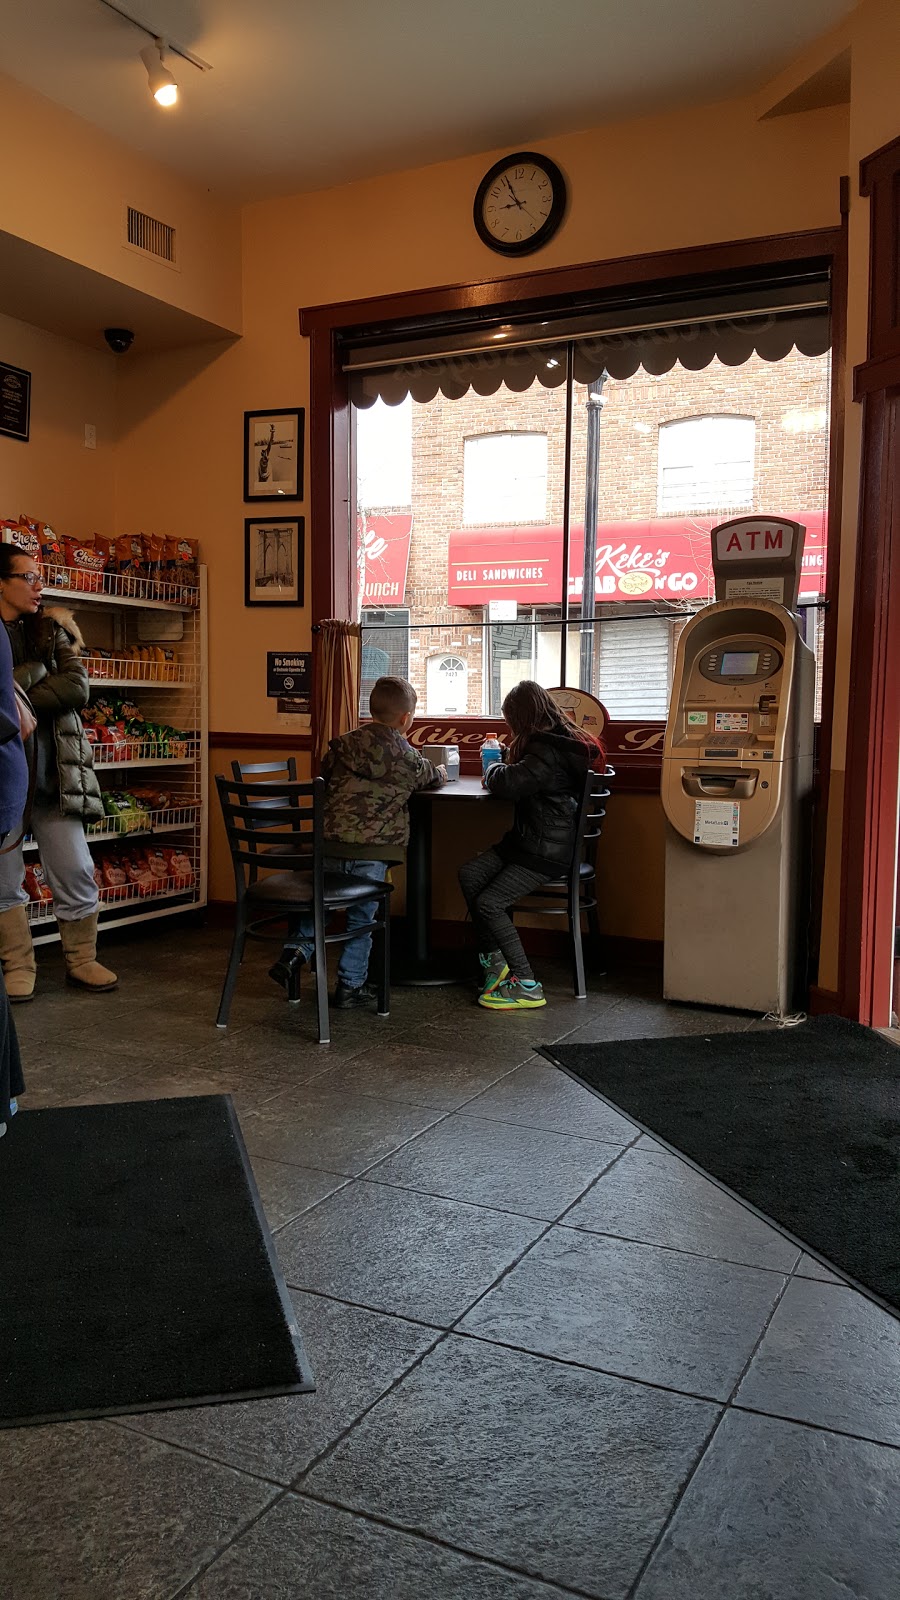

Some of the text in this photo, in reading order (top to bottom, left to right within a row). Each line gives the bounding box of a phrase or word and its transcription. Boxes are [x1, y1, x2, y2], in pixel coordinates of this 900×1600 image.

[514, 167, 525, 180] 12
[530, 170, 537, 181] 1
[537, 179, 549, 190] 2
[490, 186, 501, 199] 10
[541, 195, 552, 203] 3
[486, 205, 497, 213] 9
[490, 218, 500, 229] 8
[501, 227, 510, 238] 7
[515, 229, 523, 241] 6
[726, 530, 783, 552] ATM
[595, 543, 670, 577] Keke's
[456, 567, 543, 581] DELI SANDWICHES
[363, 582, 399, 597] UNCH
[275, 658, 304, 667] No Smoking
